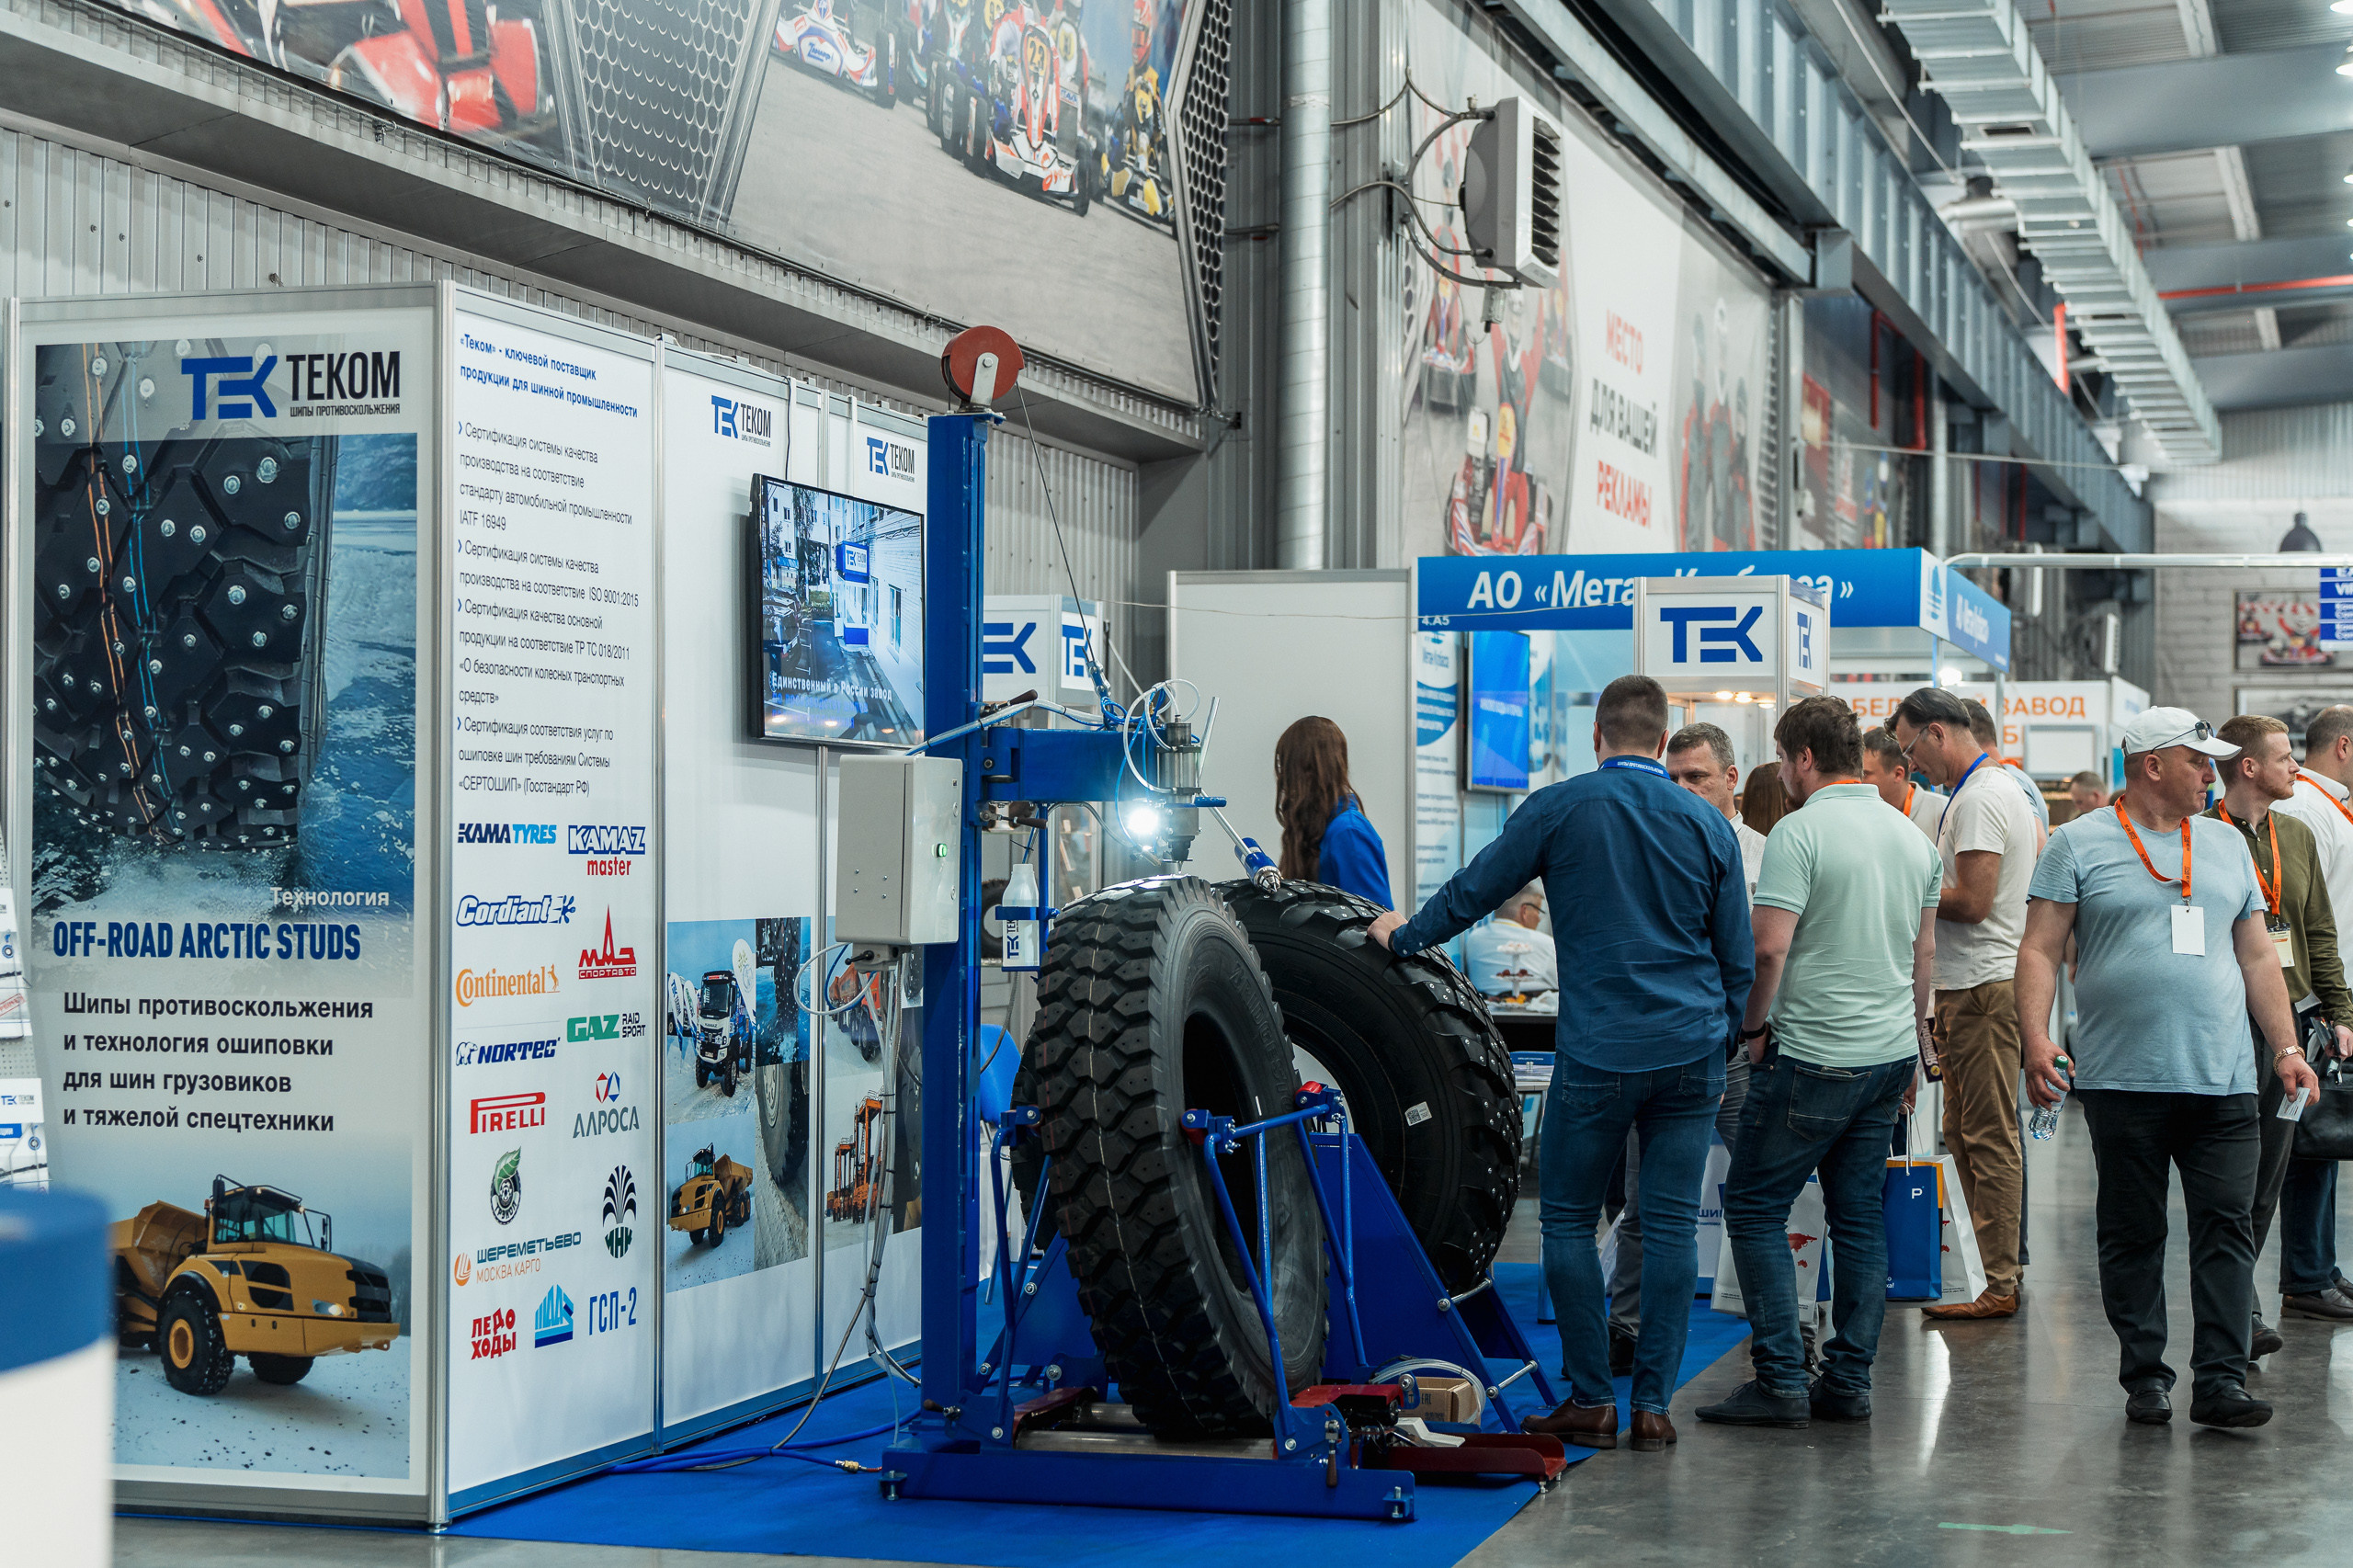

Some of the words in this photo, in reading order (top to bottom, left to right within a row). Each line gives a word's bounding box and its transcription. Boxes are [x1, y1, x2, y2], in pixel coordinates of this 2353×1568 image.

[1607, 309, 1643, 375] МЕСТО
[460, 334, 496, 354] «Теком»
[506, 347, 549, 368] ключевой
[551, 358, 597, 381] поставщик
[287, 351, 400, 402] ТЕКОМ
[460, 366, 510, 387] продукции
[513, 378, 528, 391] для
[531, 383, 564, 400] шинной
[566, 391, 638, 417] промышленности
[290, 405, 314, 417] ШИПЫ
[316, 403, 401, 416] ПРОТИВОСКОЛЬЖЕНИЯ
[741, 403, 771, 438] ТЕКОМ
[1590, 378, 1615, 436] ДЛЯ
[1619, 393, 1657, 460] ВАШЕЙ
[465, 422, 528, 449] Сертификация
[529, 437, 563, 456] системы
[564, 446, 598, 463] качества
[460, 453, 519, 475] производства
[521, 466, 530, 478] на
[532, 467, 585, 489] соответствие
[890, 443, 915, 474] ТЕКОМ
[460, 483, 503, 505] стандарту
[506, 492, 567, 513] автомобильной
[569, 503, 632, 525] промышленности
[1597, 460, 1652, 529] РЕКЛАМЫ
[460, 509, 479, 526] IATF
[482, 513, 506, 530] 16949
[465, 540, 528, 563] Сертификация
[529, 551, 563, 569] системы
[565, 559, 599, 574] качества
[460, 572, 519, 591] производства
[521, 581, 531, 592] на
[533, 582, 585, 599] соответствие
[589, 586, 602, 602] ISO
[604, 589, 639, 608] 9001:2015
[1466, 571, 1522, 609] АО
[464, 599, 529, 620] Сертификация
[530, 610, 565, 625] качества
[567, 616, 603, 630] основной
[460, 631, 506, 648] продукции
[508, 635, 517, 648] на
[520, 637, 574, 653] соответствие
[575, 641, 585, 655] ТР
[587, 642, 597, 657] ТС
[598, 643, 630, 660] 018/2011
[473, 659, 532, 678] безопасности
[535, 667, 572, 681] колесных
[574, 671, 625, 687] транспортных
[459, 690, 499, 705] средств»
[464, 717, 528, 736] Сертификация
[529, 724, 582, 738] соответствия
[584, 729, 603, 743] услуг
[605, 729, 613, 741] по
[459, 749, 503, 762] ошиповке
[506, 752, 522, 764] шин
[525, 751, 576, 767] требованиям
[578, 753, 610, 768] Системы
[459, 776, 521, 791] «СЕРТОШИП»
[524, 778, 574, 797] (Госстандарт
[576, 780, 590, 798] РФ)
[458, 824, 511, 844] KAMA
[513, 824, 557, 845] TYRES
[568, 825, 646, 855] KAMAZ
[587, 857, 631, 876] master
[270, 887, 390, 907] Технология
[456, 894, 552, 926] Cordiant
[53, 921, 173, 958] OFF-ROAD
[179, 923, 271, 960] ARCTIC
[278, 924, 361, 960] STUDS
[456, 966, 546, 1007] Continental
[578, 967, 637, 980] СПОРТАВТО
[63, 993, 131, 1016] Шипы
[138, 997, 373, 1019] противоскольжения
[622, 1012, 640, 1025] RAID
[567, 1014, 620, 1042] GAZ
[622, 1025, 646, 1039] SPORT
[63, 1034, 75, 1051] и
[85, 1035, 209, 1053] технология
[217, 1037, 334, 1056] ошиповки
[478, 1040, 556, 1064] NORTEC
[63, 1071, 101, 1092] для
[109, 1072, 154, 1090] шин
[163, 1074, 292, 1095] грузовиков
[63, 1108, 75, 1125] и
[84, 1106, 178, 1128] тяжелой
[186, 1111, 335, 1132] спецтехники
[471, 1092, 546, 1134] PIRELLI
[477, 1232, 582, 1264] ШЕРЕМЕТЬЕВО
[476, 1265, 512, 1283] МОСКВА
[515, 1258, 541, 1276] КАРГО
[589, 1287, 637, 1335] ГСП-2
[472, 1331, 517, 1360] ХОДЫ
